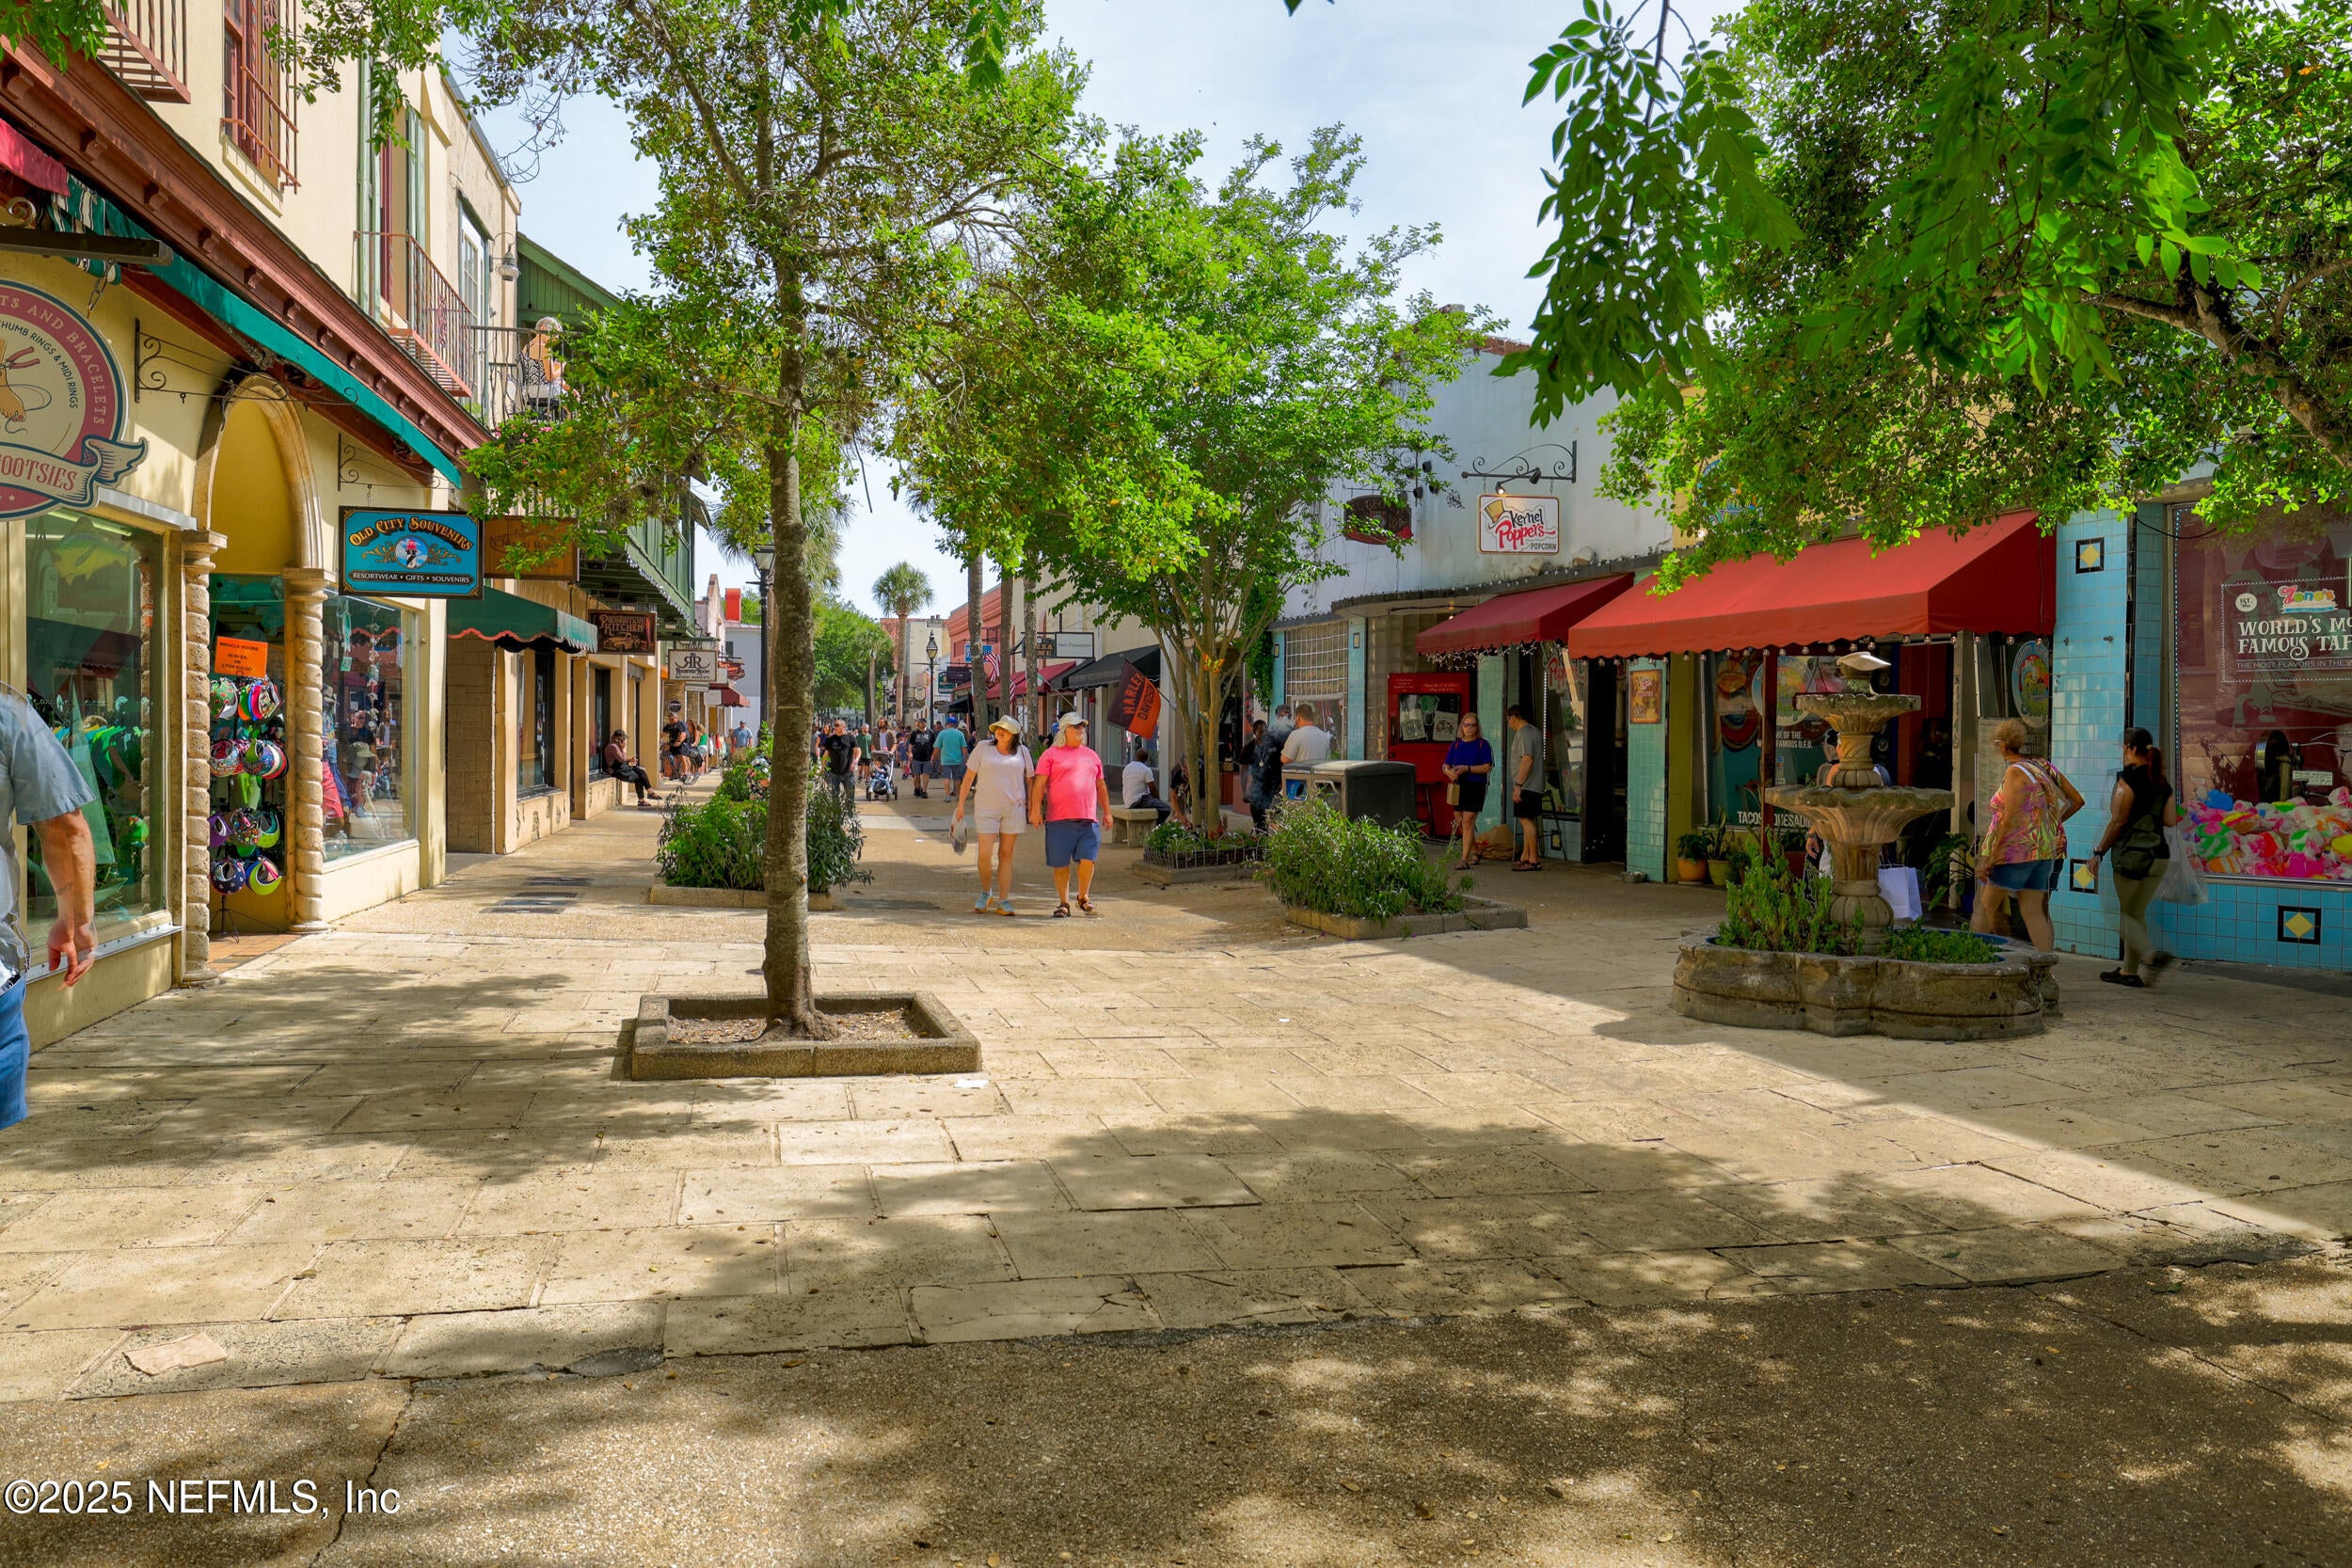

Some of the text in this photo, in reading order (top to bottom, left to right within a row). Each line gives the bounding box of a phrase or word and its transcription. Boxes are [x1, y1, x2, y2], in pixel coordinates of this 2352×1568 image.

[0, 321, 29, 336] HUMB
[30, 332, 56, 355] RINGS
[58, 360, 72, 381] MIDI
[68, 381, 79, 408] RINGS
[27, 305, 65, 330] AND
[66, 332, 107, 424] BRACELETS
[0, 454, 77, 491] OOTSIES
[349, 527, 373, 546] OLD
[375, 518, 405, 534] CITY
[408, 516, 473, 550] SOUVENIRS
[1530, 542, 1557, 550] POPCORN
[353, 571, 398, 580] RESORTWEAR
[605, 623, 644, 637] KITCHEN
[2238, 615, 2322, 636] WORLD'S
[2237, 636, 2310, 661] FAMOUS
[1137, 683, 1155, 721] DAVIDSO
[1791, 731, 1802, 739] THE
